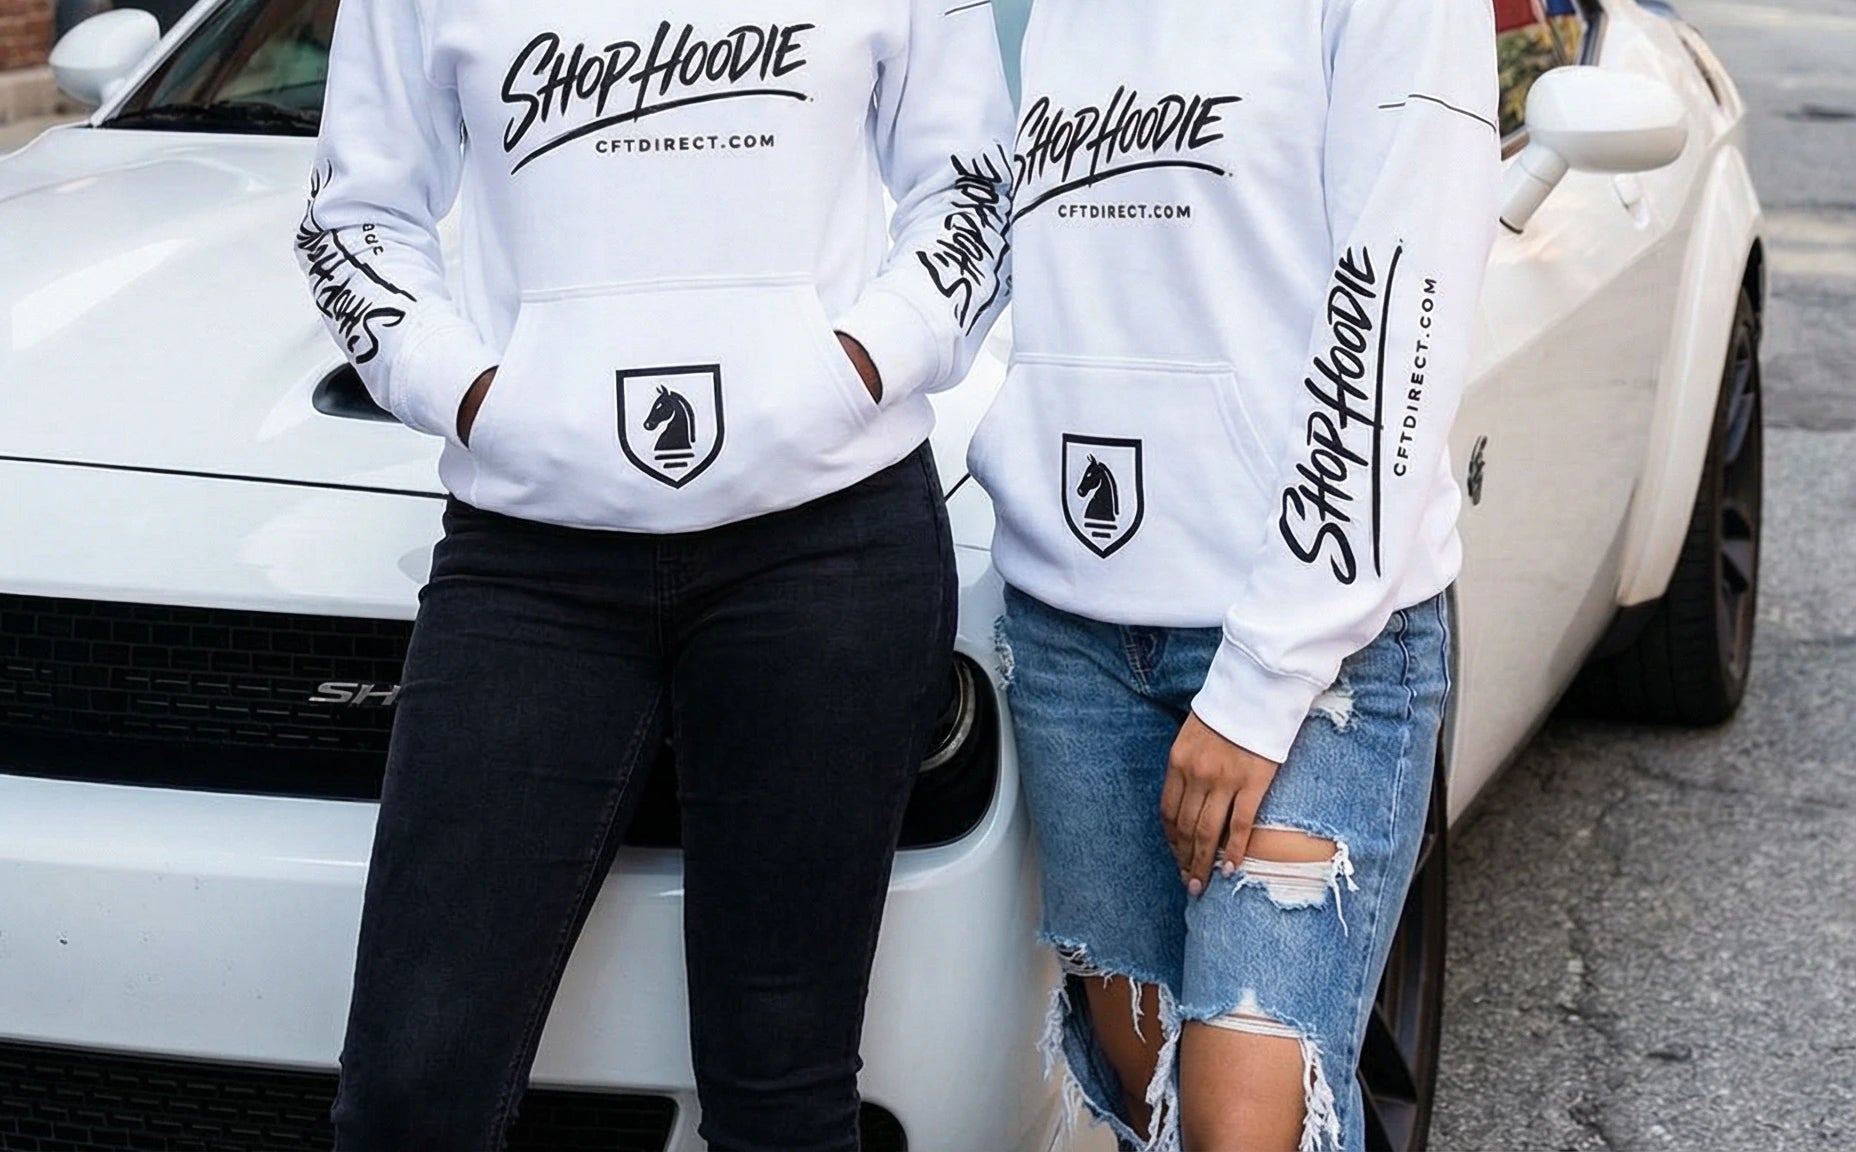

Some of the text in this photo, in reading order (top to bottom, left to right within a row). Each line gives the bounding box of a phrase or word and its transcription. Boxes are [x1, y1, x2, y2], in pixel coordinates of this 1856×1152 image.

[595, 134, 775, 154] CFTDIRECT.COM
[1057, 204, 1191, 219] CFTDIRECT.COM
[1393, 278, 1437, 477] CFTDIRECT.COM
